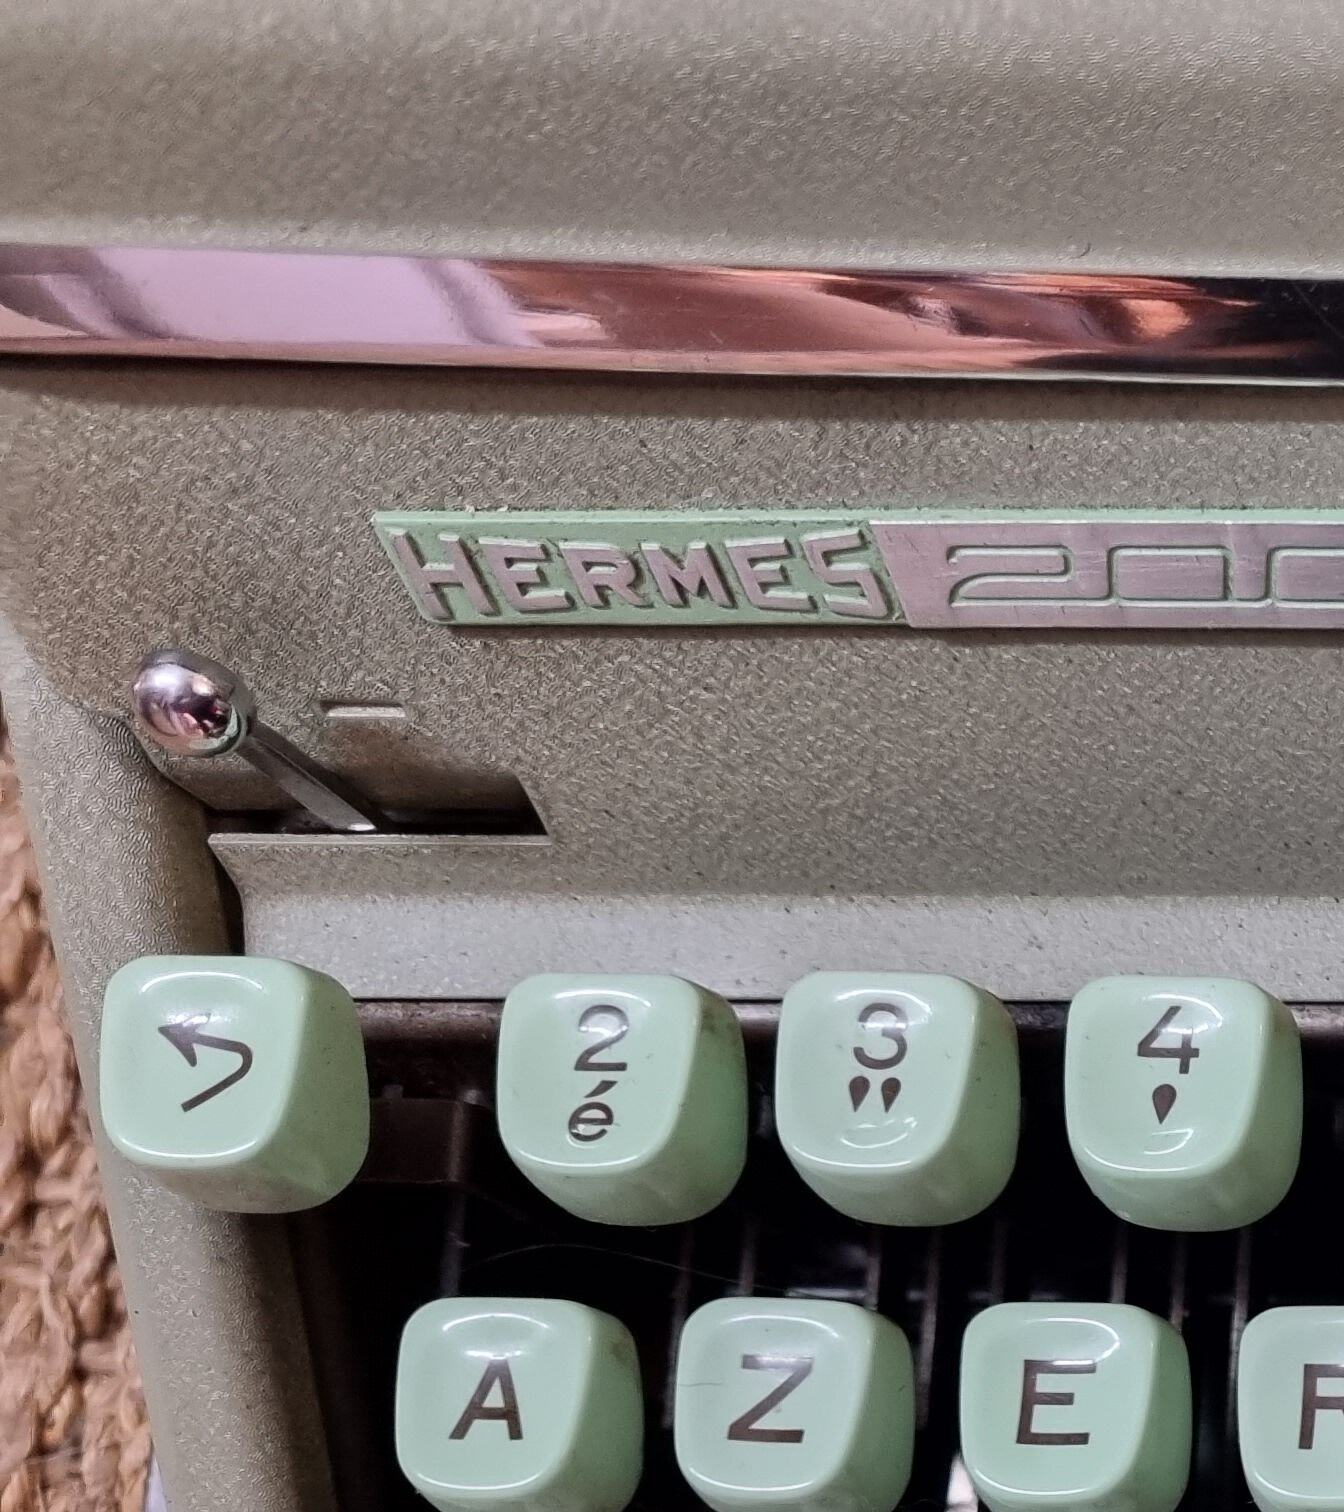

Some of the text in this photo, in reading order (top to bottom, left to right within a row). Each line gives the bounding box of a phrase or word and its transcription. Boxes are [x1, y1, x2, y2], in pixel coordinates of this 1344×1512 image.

[382, 527, 904, 620] HERMES
[573, 1004, 628, 1072] 2
[853, 1002, 908, 1069] 3
[1136, 1005, 1200, 1075] 4
[567, 1079, 618, 1142] é
[448, 1357, 524, 1442] A
[726, 1354, 810, 1444] Z
[1015, 1359, 1093, 1447] E
